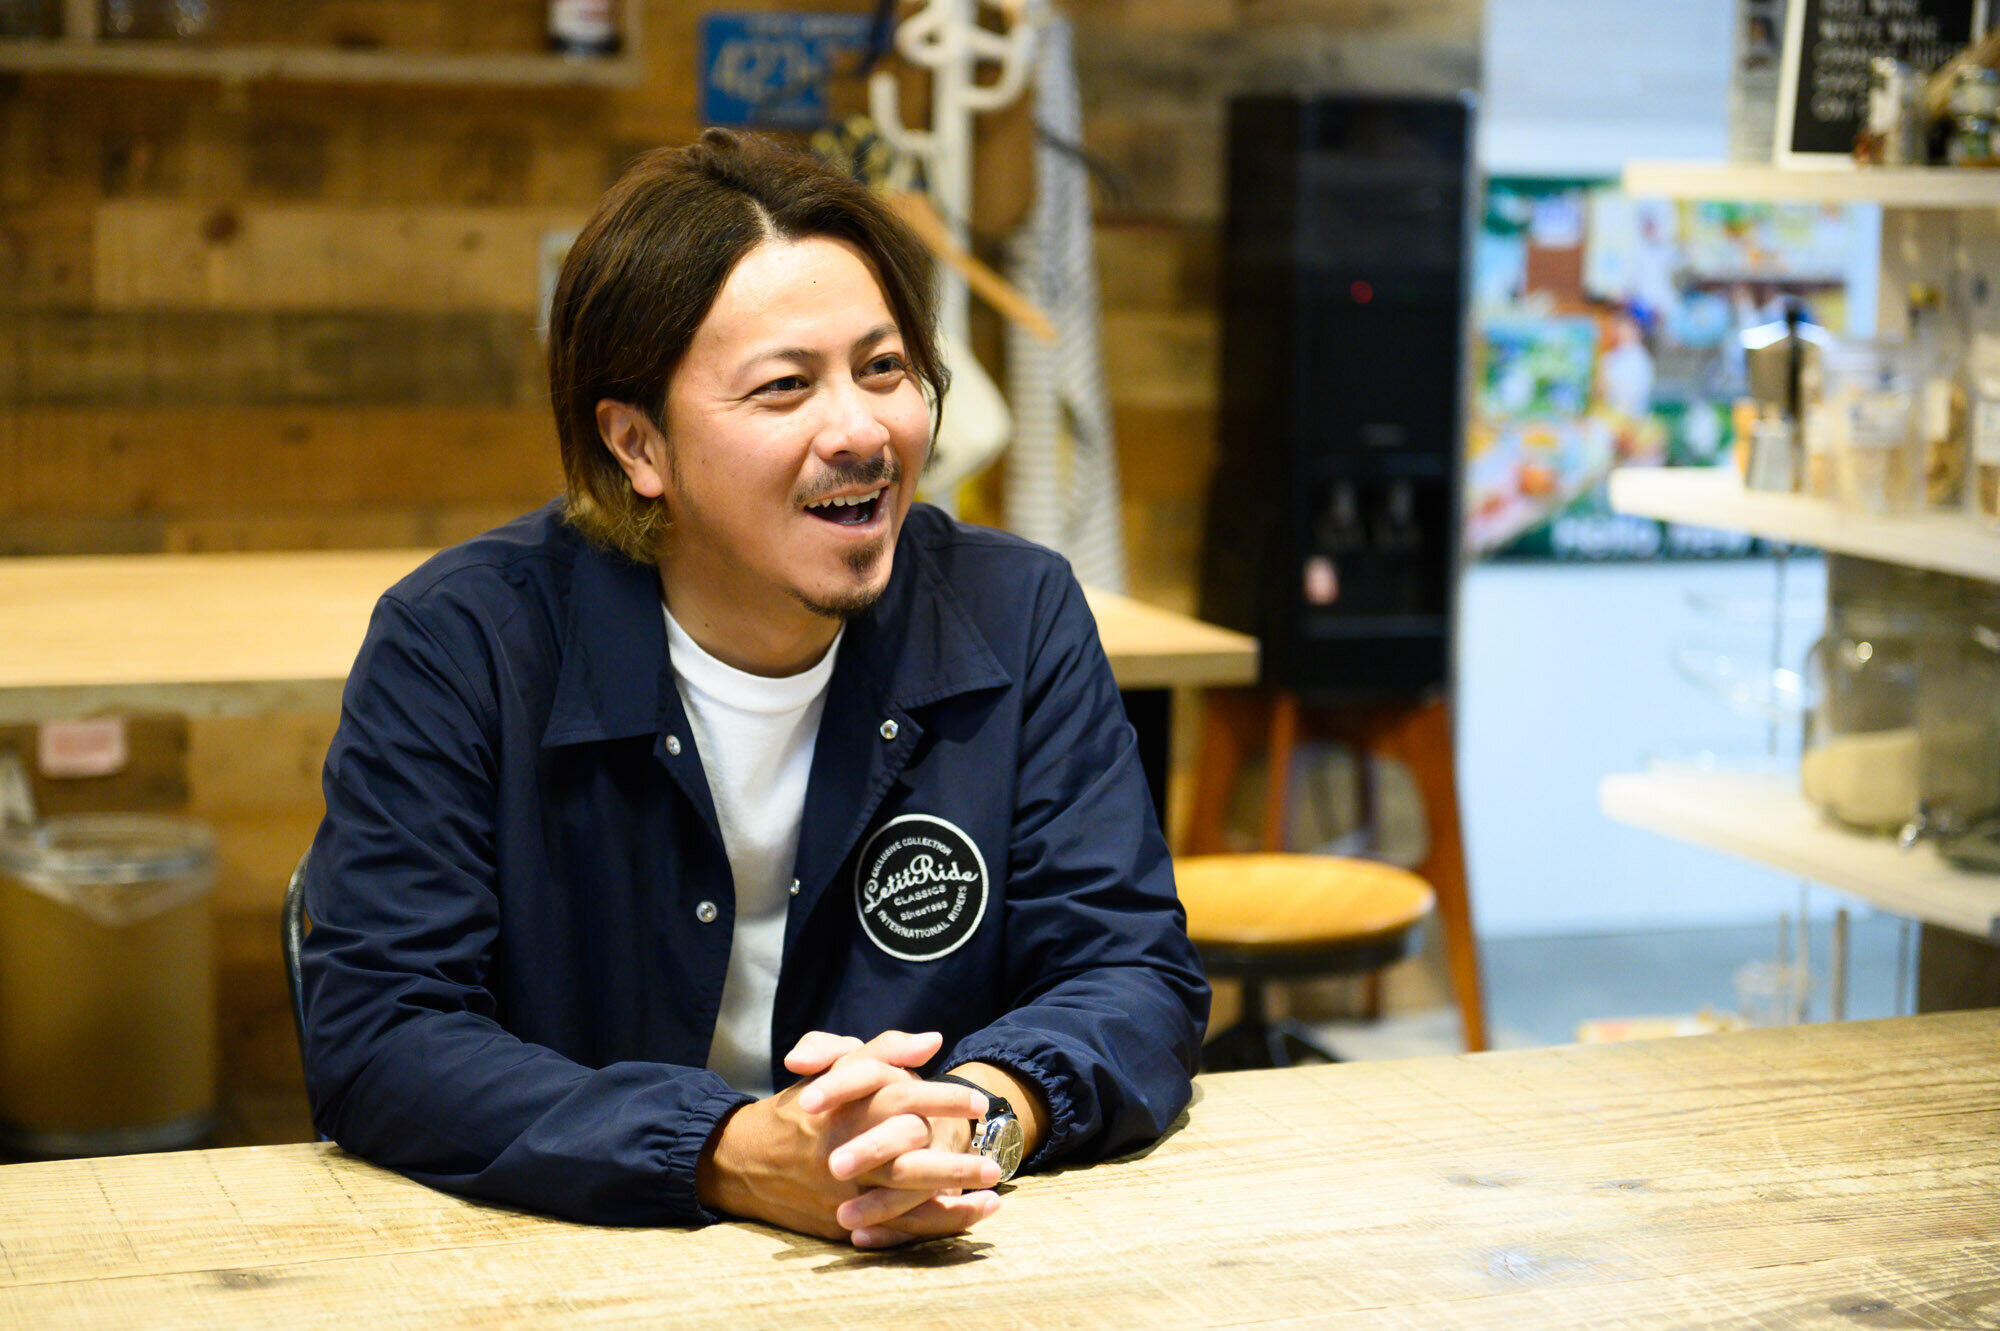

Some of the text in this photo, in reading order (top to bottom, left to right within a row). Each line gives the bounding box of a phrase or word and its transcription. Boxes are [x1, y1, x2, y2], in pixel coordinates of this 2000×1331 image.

[871, 837, 953, 879] EXCLUSIVE COLLECTION
[877, 885, 968, 939] INTERNATIONAL RIDERS
[893, 884, 947, 906] CLASSICS
